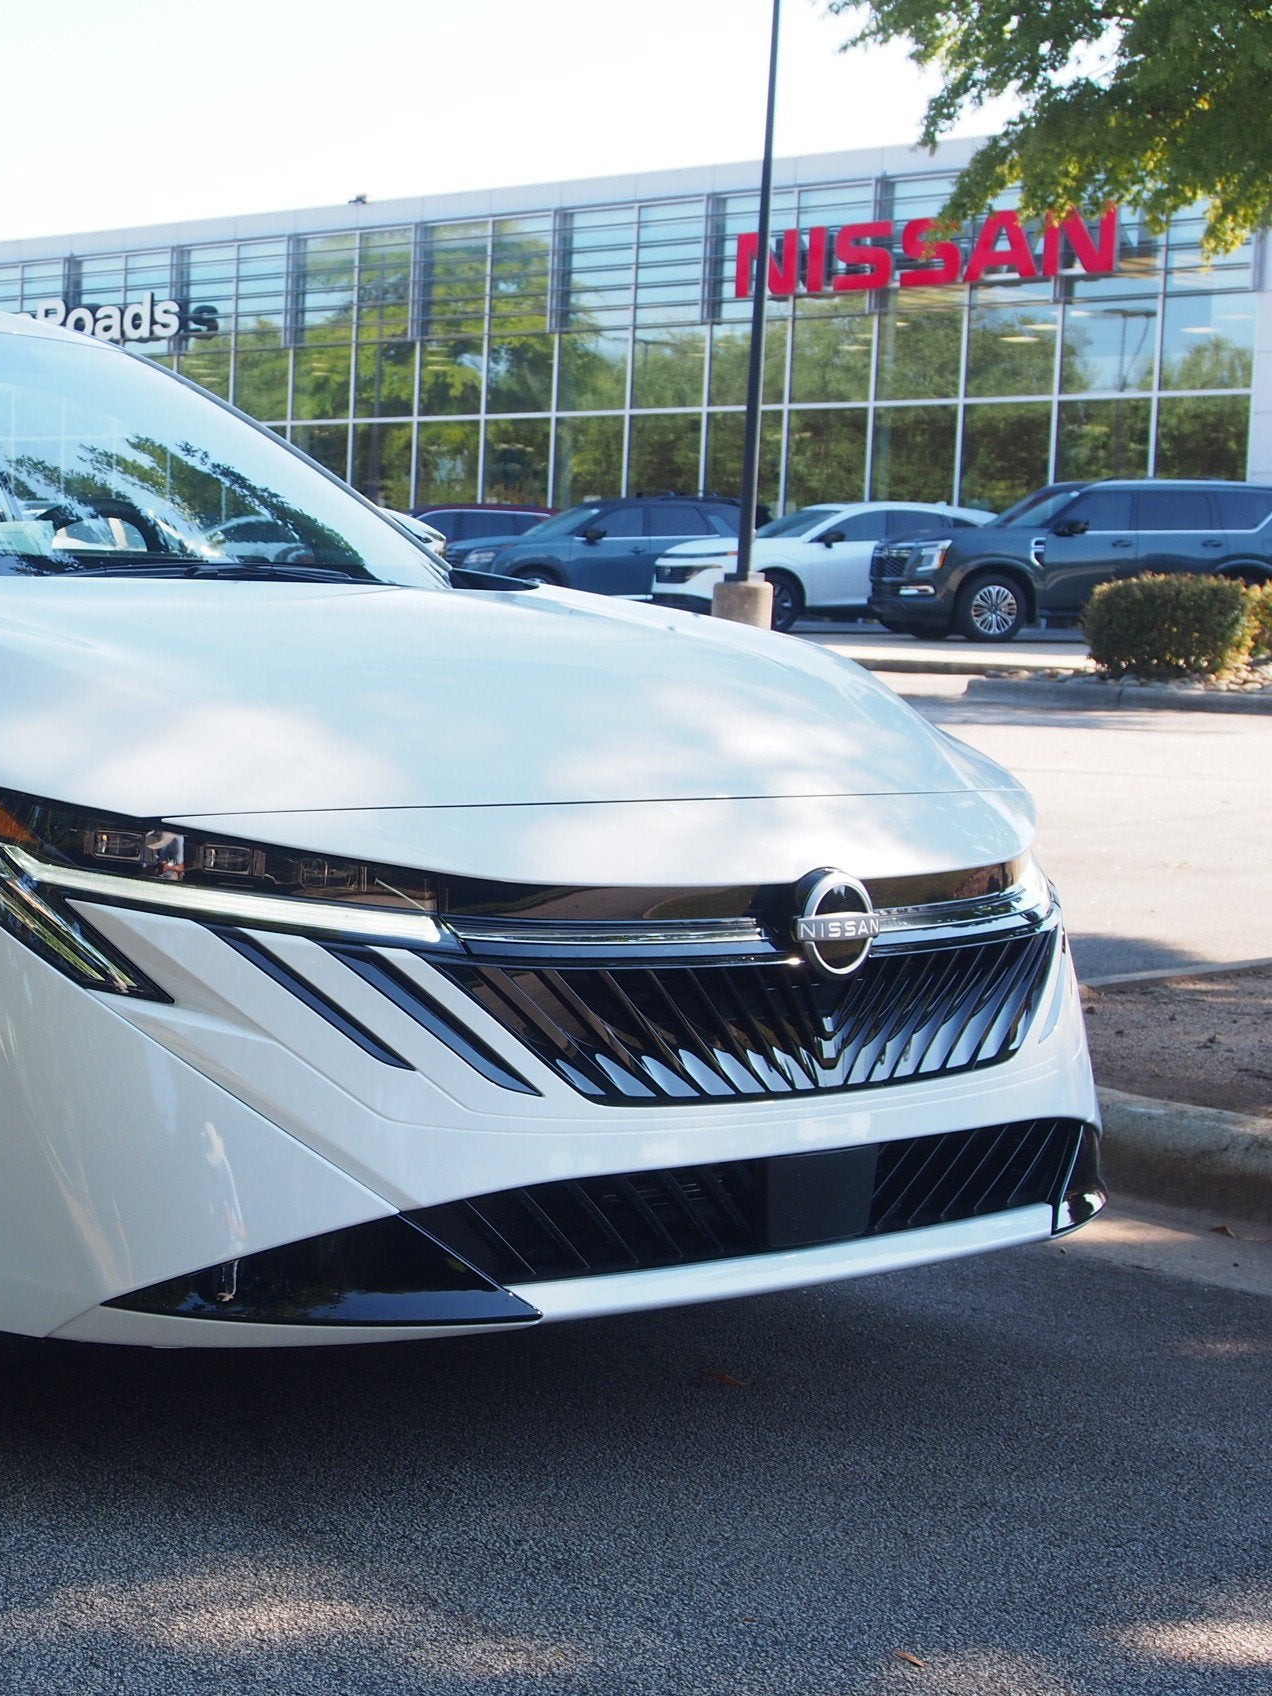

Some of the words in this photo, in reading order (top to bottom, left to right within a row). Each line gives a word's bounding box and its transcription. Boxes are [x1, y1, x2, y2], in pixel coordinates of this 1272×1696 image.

[735, 200, 1118, 298] NISSAN
[18, 291, 180, 341] Roads
[800, 918, 880, 938] NISSAN
